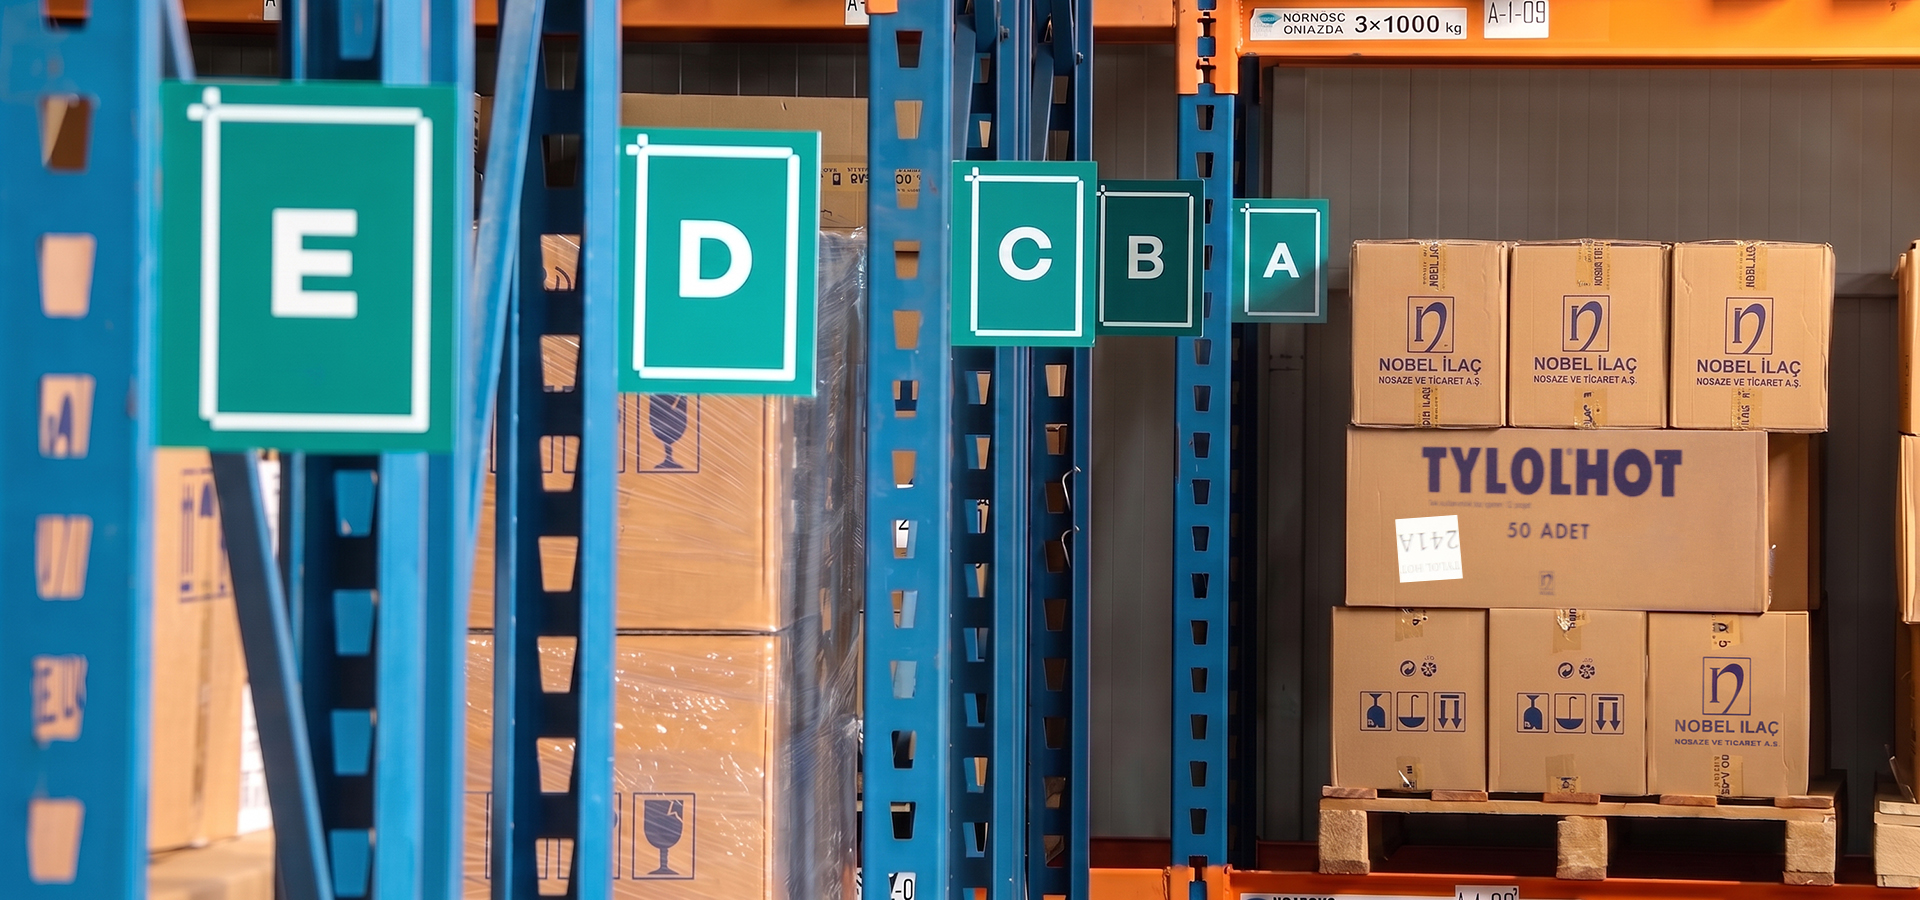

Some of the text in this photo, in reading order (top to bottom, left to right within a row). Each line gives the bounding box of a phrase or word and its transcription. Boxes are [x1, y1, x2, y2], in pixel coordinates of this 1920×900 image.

[1487, 0, 1546, 24] A-1-09
[1283, 24, 1344, 35] ONIAZDA
[1445, 22, 1463, 36] kg
[270, 207, 358, 319] E
[679, 219, 753, 299] D
[999, 226, 1053, 281] C
[1128, 235, 1165, 280] B
[1262, 242, 1300, 279] A
[1379, 355, 1482, 375] NOBEL İLAÇ
[1534, 355, 1638, 374] NOBEL İLAÇ
[1696, 358, 1801, 377] NOBEL İLAÇ
[1378, 376, 1413, 385] NOSAZE
[1415, 376, 1426, 385] VE
[1428, 375, 1464, 385] TİCARET
[1533, 375, 1568, 384] NOSAZE
[1570, 375, 1581, 384] VE
[1584, 374, 1619, 384] TİCARET
[1696, 377, 1731, 386] NOSAZE
[1733, 378, 1745, 387] VE
[1747, 376, 1783, 387] TİCARET
[1507, 522, 1590, 540] 50 ADET
[1674, 719, 1735, 733] NOBEL
